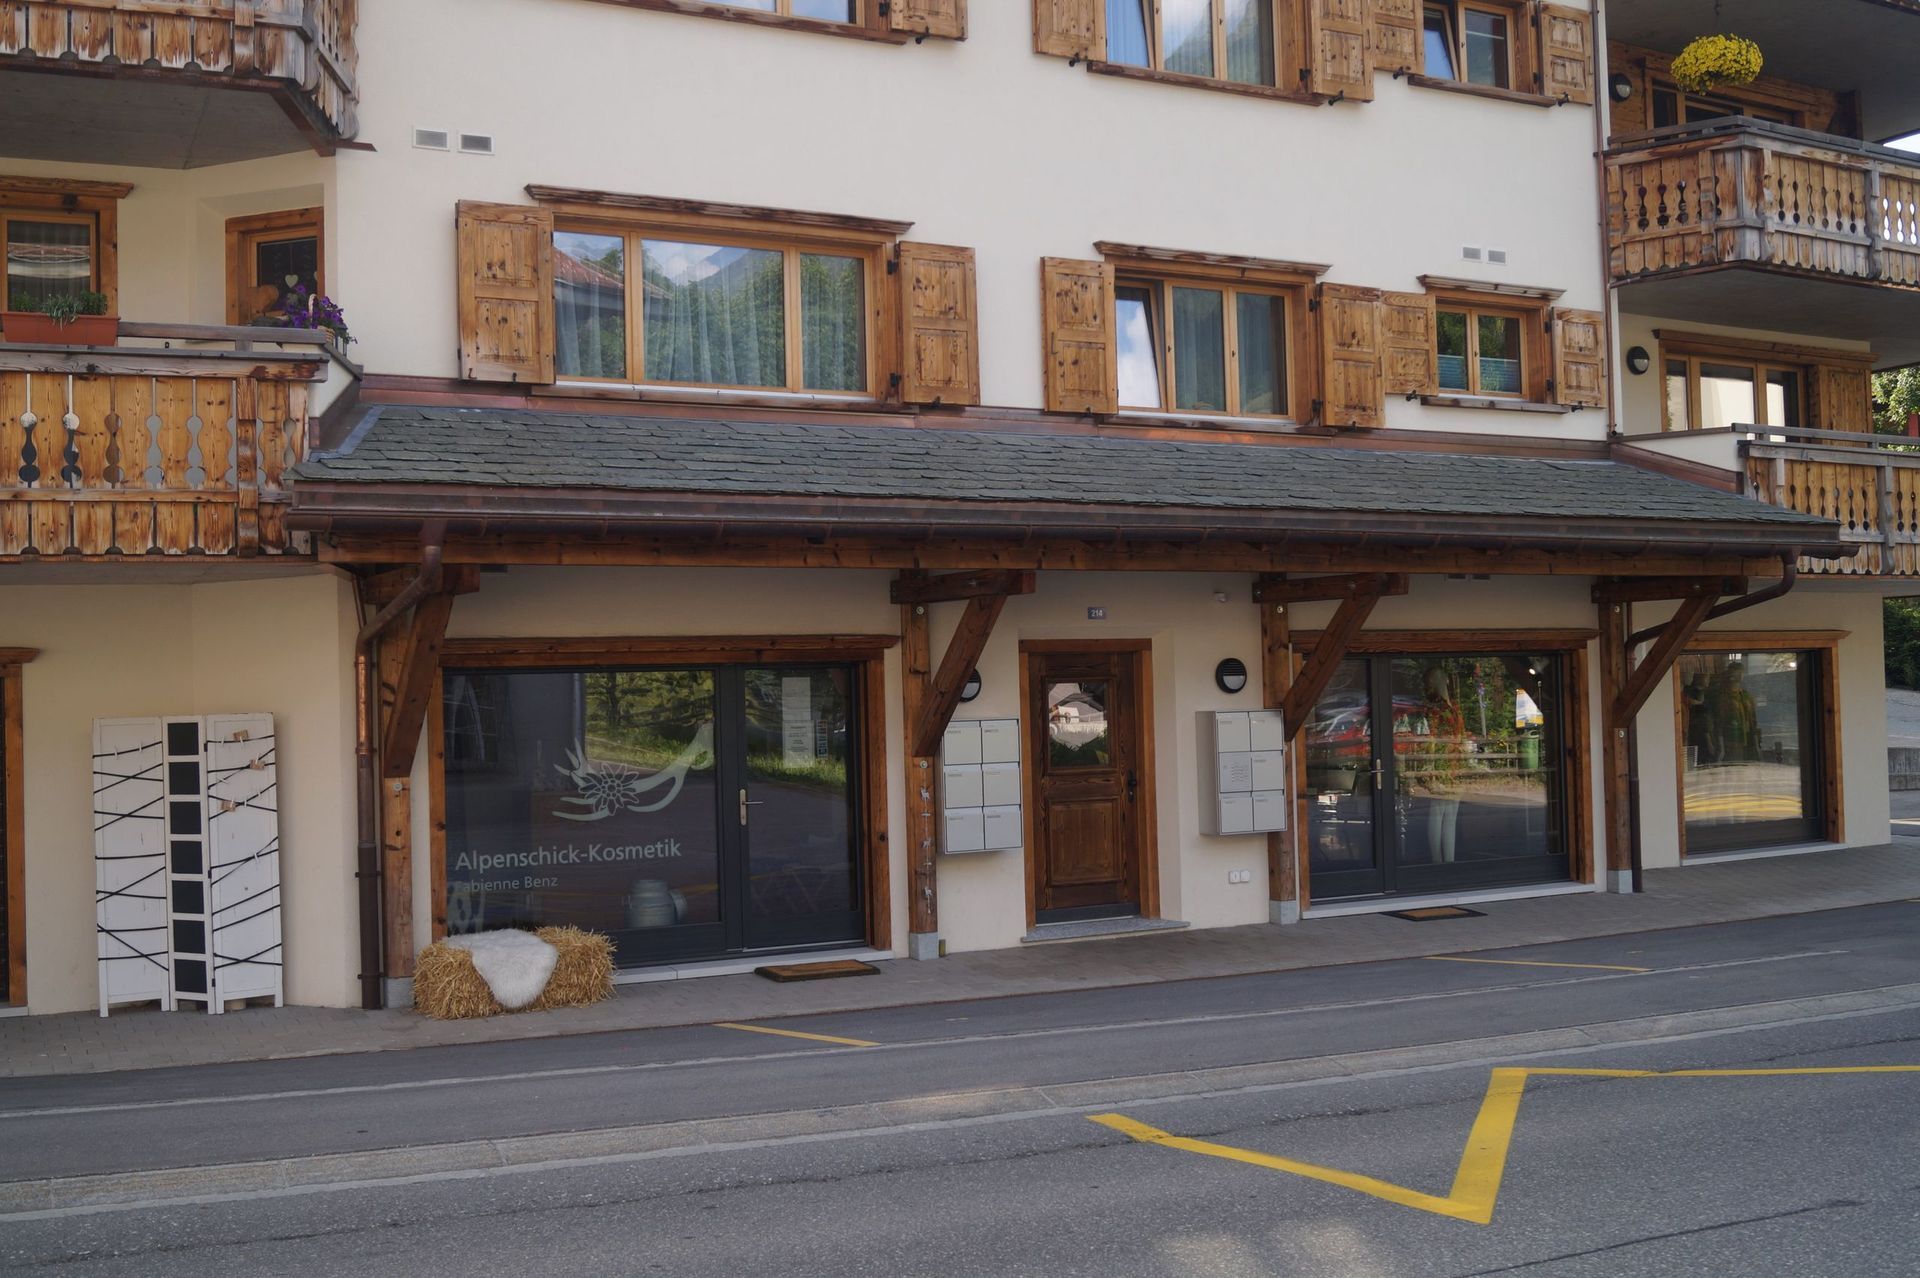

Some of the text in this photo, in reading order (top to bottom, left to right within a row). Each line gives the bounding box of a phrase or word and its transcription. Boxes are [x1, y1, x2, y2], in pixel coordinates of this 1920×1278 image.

[455, 838, 682, 873] Alpenschick-Kosmetik
[455, 876, 559, 893] Fabienne Benz
